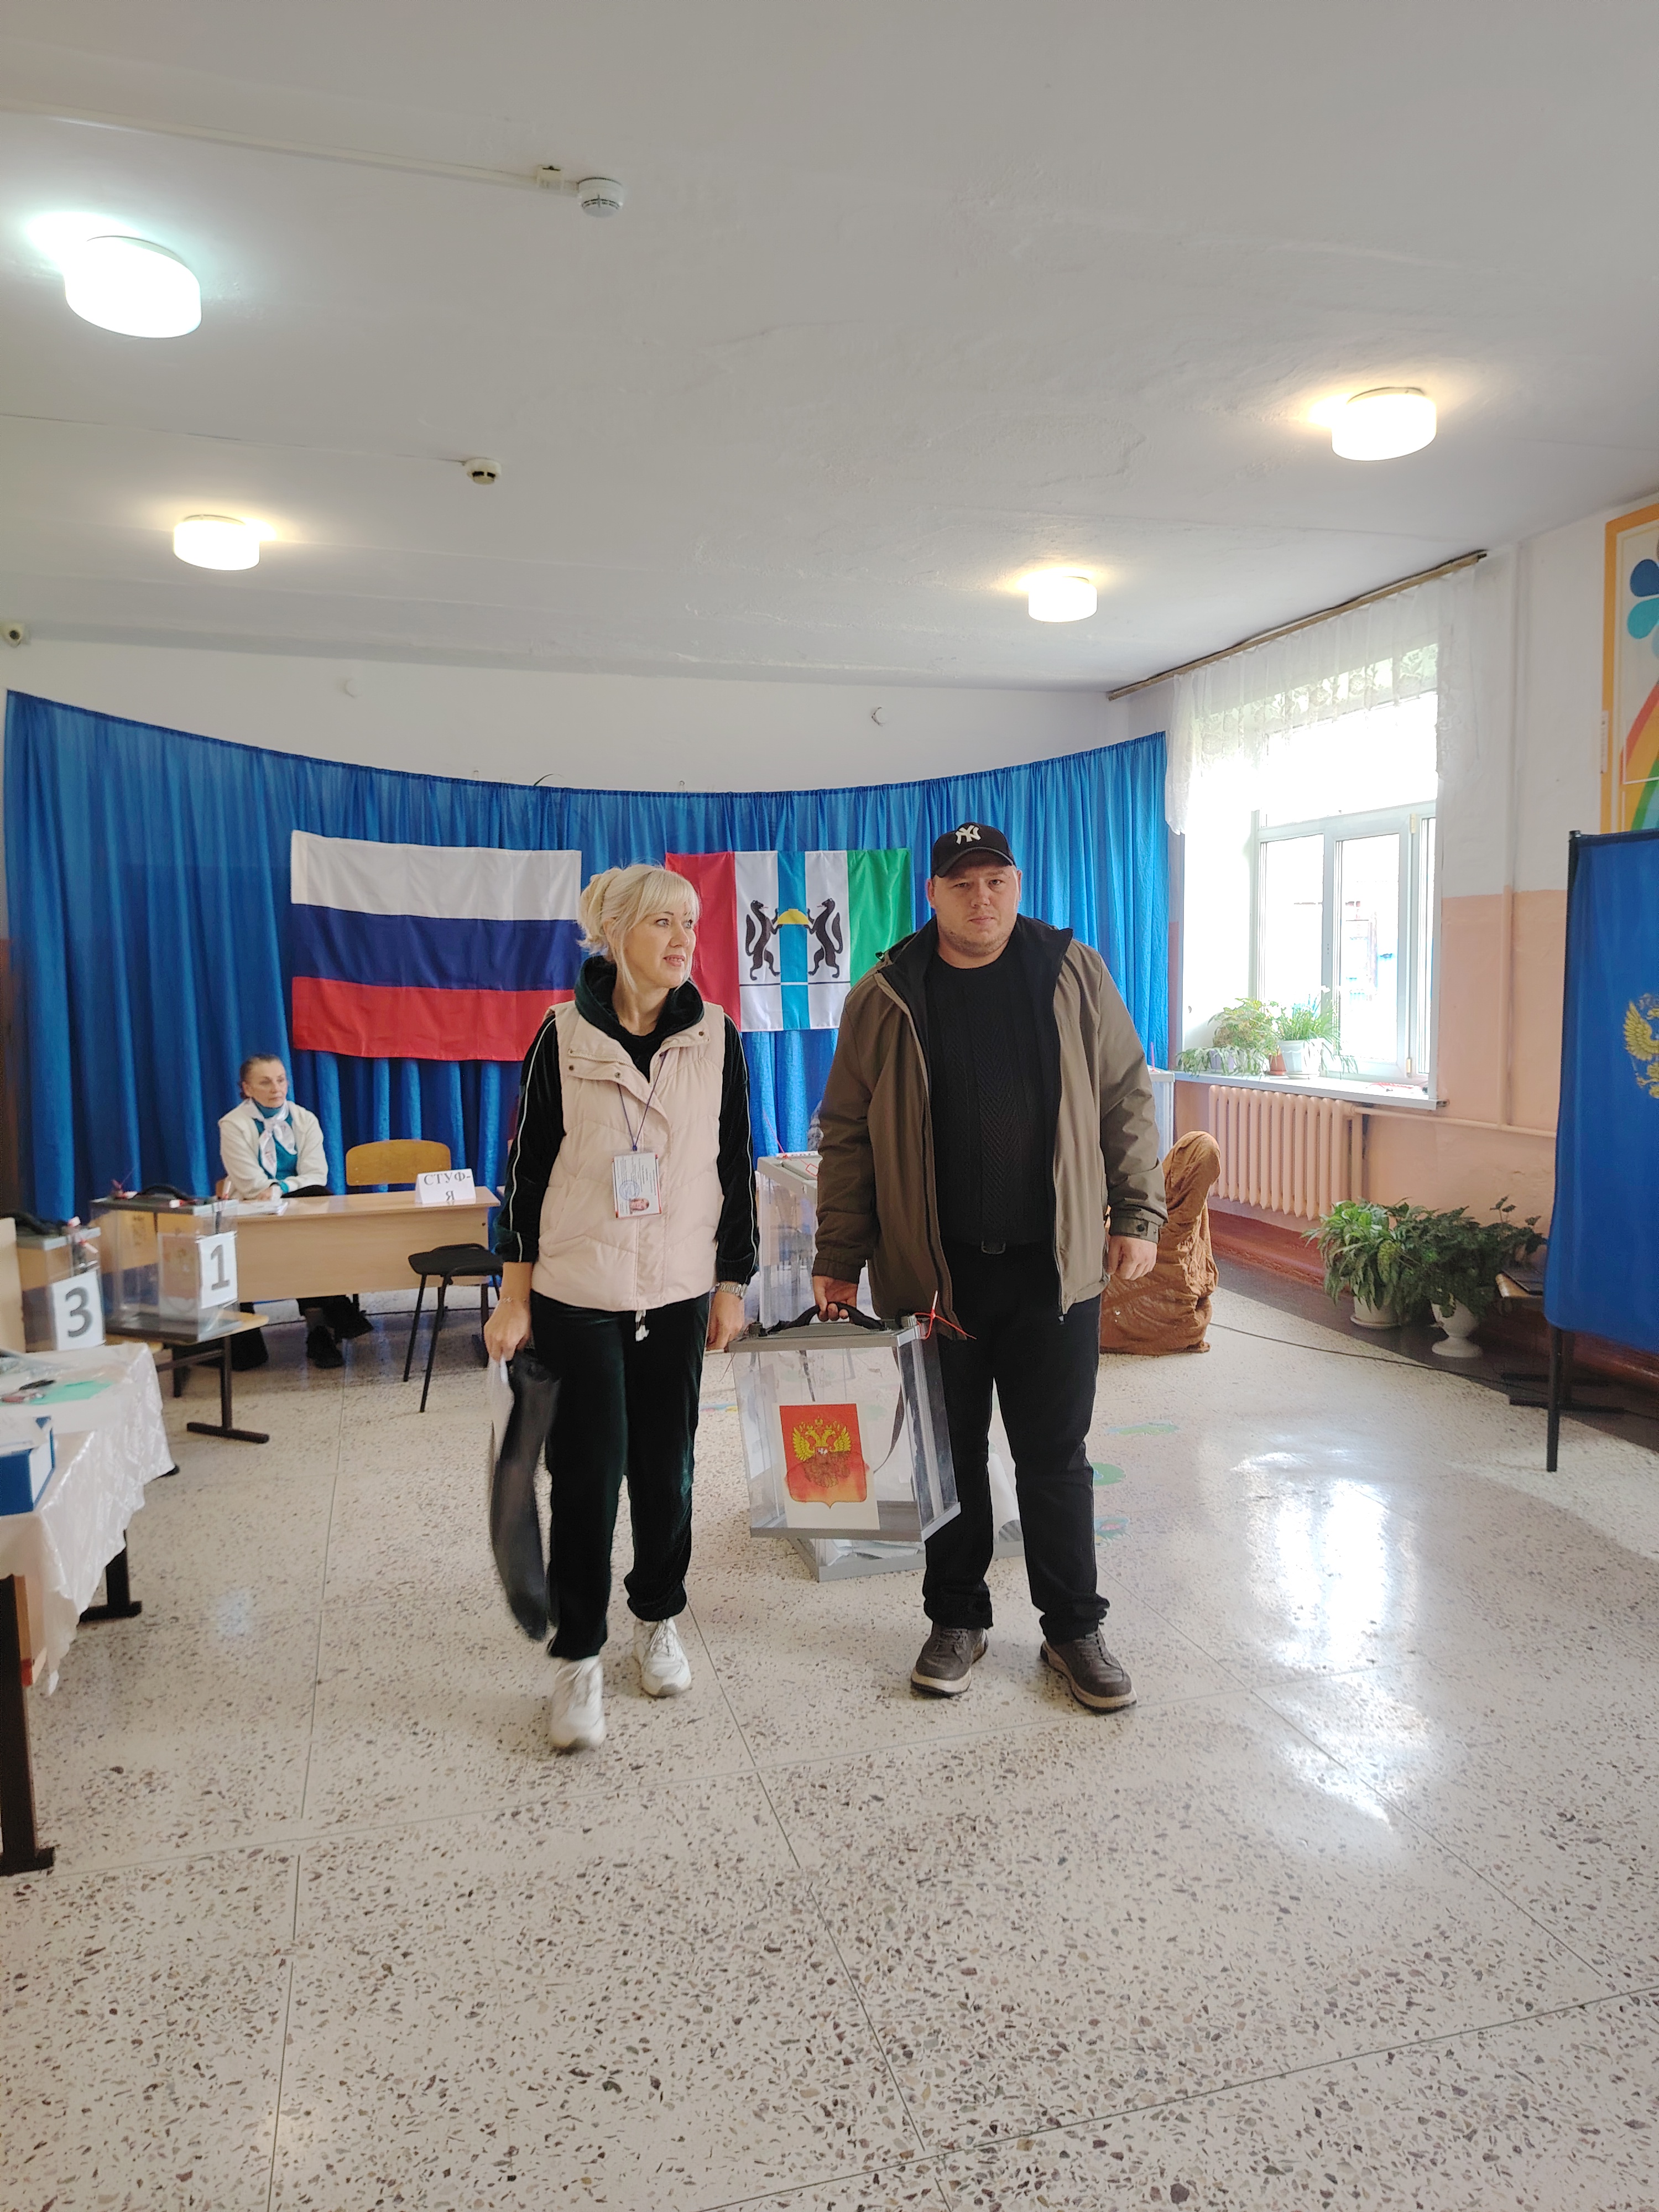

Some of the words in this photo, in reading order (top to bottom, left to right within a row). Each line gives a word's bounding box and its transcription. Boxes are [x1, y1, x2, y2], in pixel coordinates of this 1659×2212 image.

[955, 825, 982, 845] NY
[445, 1191, 455, 1201] Я
[210, 1244, 230, 1290] 1
[65, 1287, 92, 1338] 3
